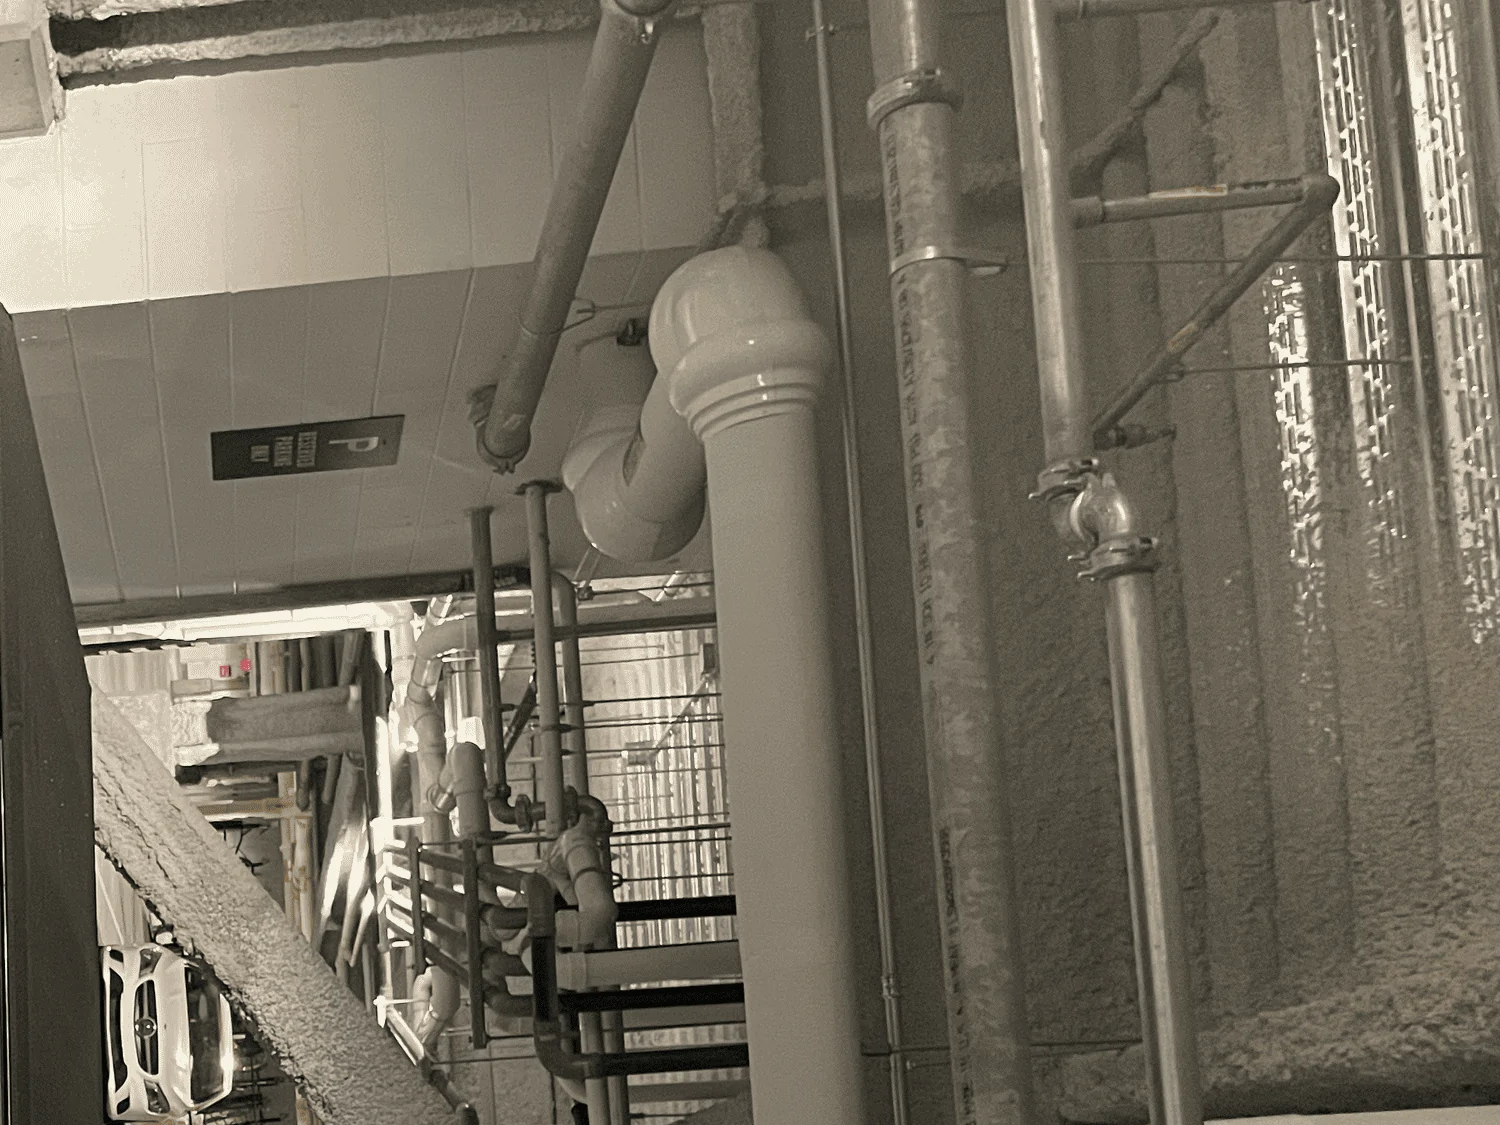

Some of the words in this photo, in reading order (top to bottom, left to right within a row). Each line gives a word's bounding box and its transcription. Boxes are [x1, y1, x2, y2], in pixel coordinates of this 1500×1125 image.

[250, 445, 270, 463] ONLY
[273, 436, 293, 467] PARKING
[296, 431, 317, 468] RESERVED
[328, 436, 379, 453] P
